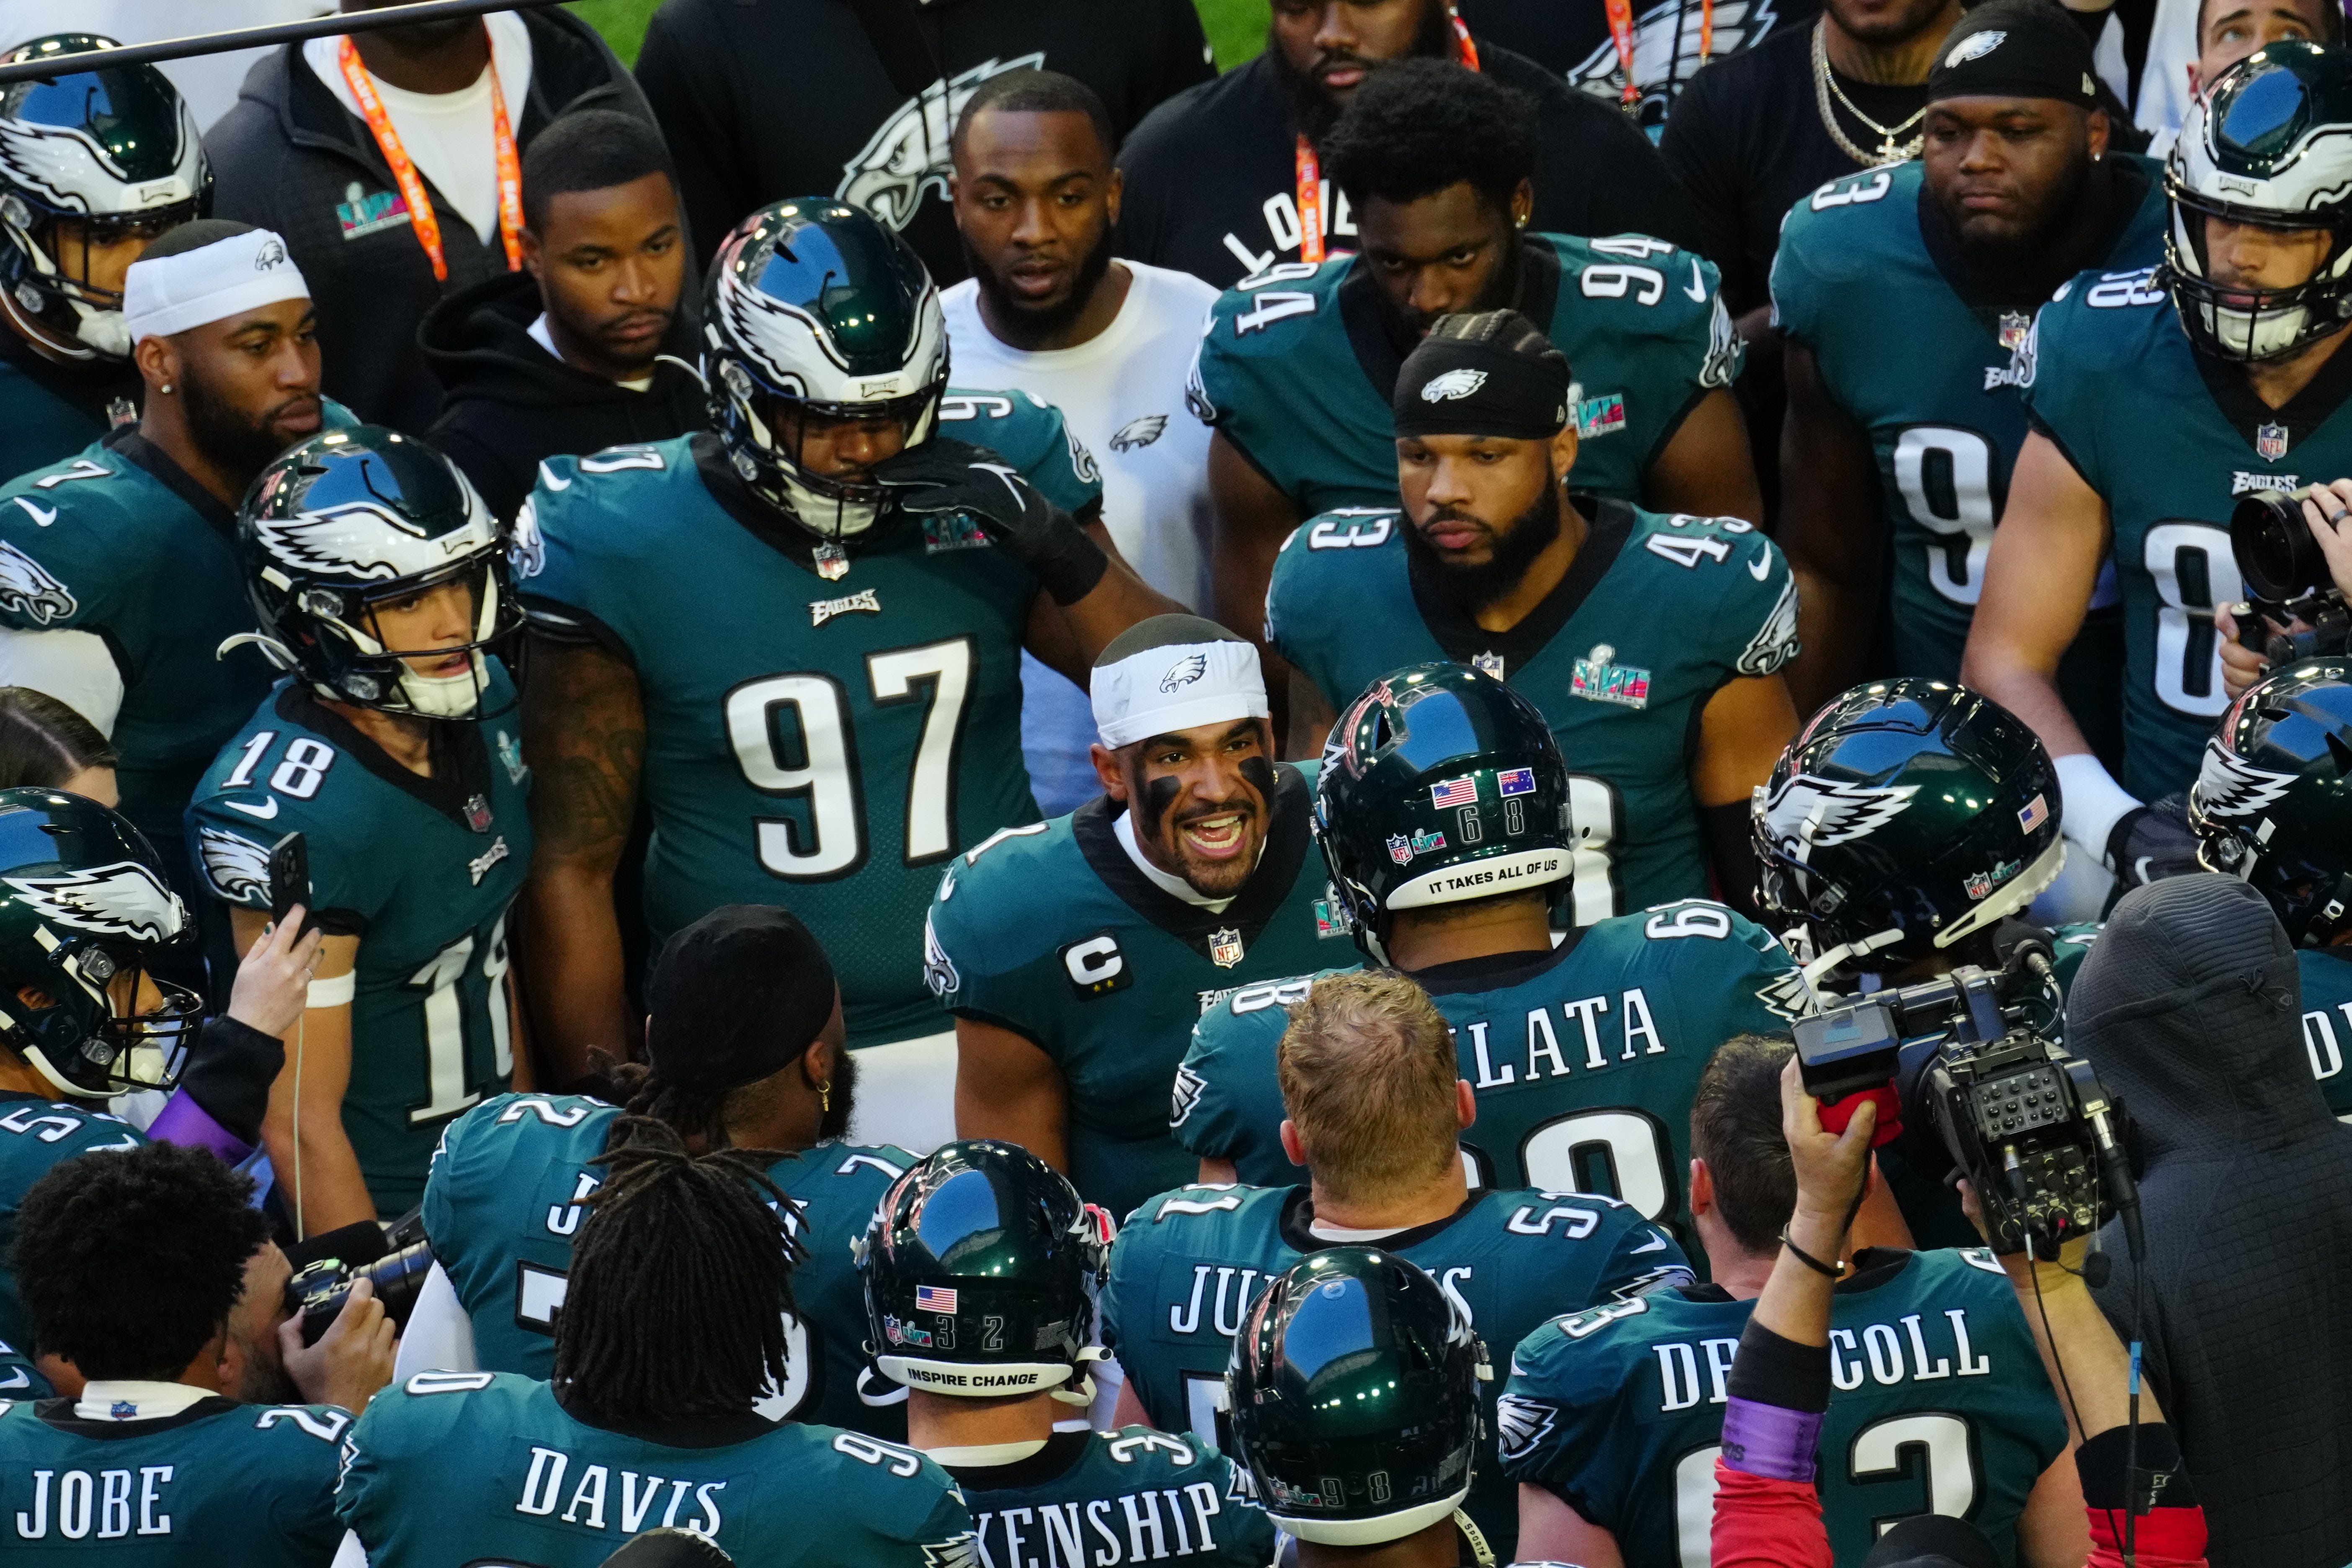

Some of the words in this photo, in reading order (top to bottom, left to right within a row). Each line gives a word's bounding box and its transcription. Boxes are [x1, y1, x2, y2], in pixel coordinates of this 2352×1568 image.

[1581, 237, 1674, 305] 94
[1235, 262, 1319, 334] 94
[2262, 438, 2282, 454] NFL
[2228, 471, 2295, 495] EAGLES
[808, 588, 881, 627] EAGLES
[220, 732, 335, 799] 18
[726, 639, 970, 875] 97
[966, 823, 1050, 868] 1
[1392, 847, 1410, 861] NFL
[1429, 881, 1442, 894] IT
[1447, 872, 1493, 890] TAKES
[1498, 866, 1522, 880] ALL
[1527, 862, 1541, 875] OF
[1544, 859, 1558, 871] US
[1065, 936, 1123, 985] C
[1216, 944, 1238, 961] NFL
[1450, 988, 1666, 1089] LATA
[908, 1368, 967, 1386] INSPIRE
[973, 1373, 1038, 1387] CHANGE
[16, 1465, 174, 1540] JOBE
[515, 1447, 727, 1538] DAVIS
[1465, 1523, 1484, 1552] SPORT
